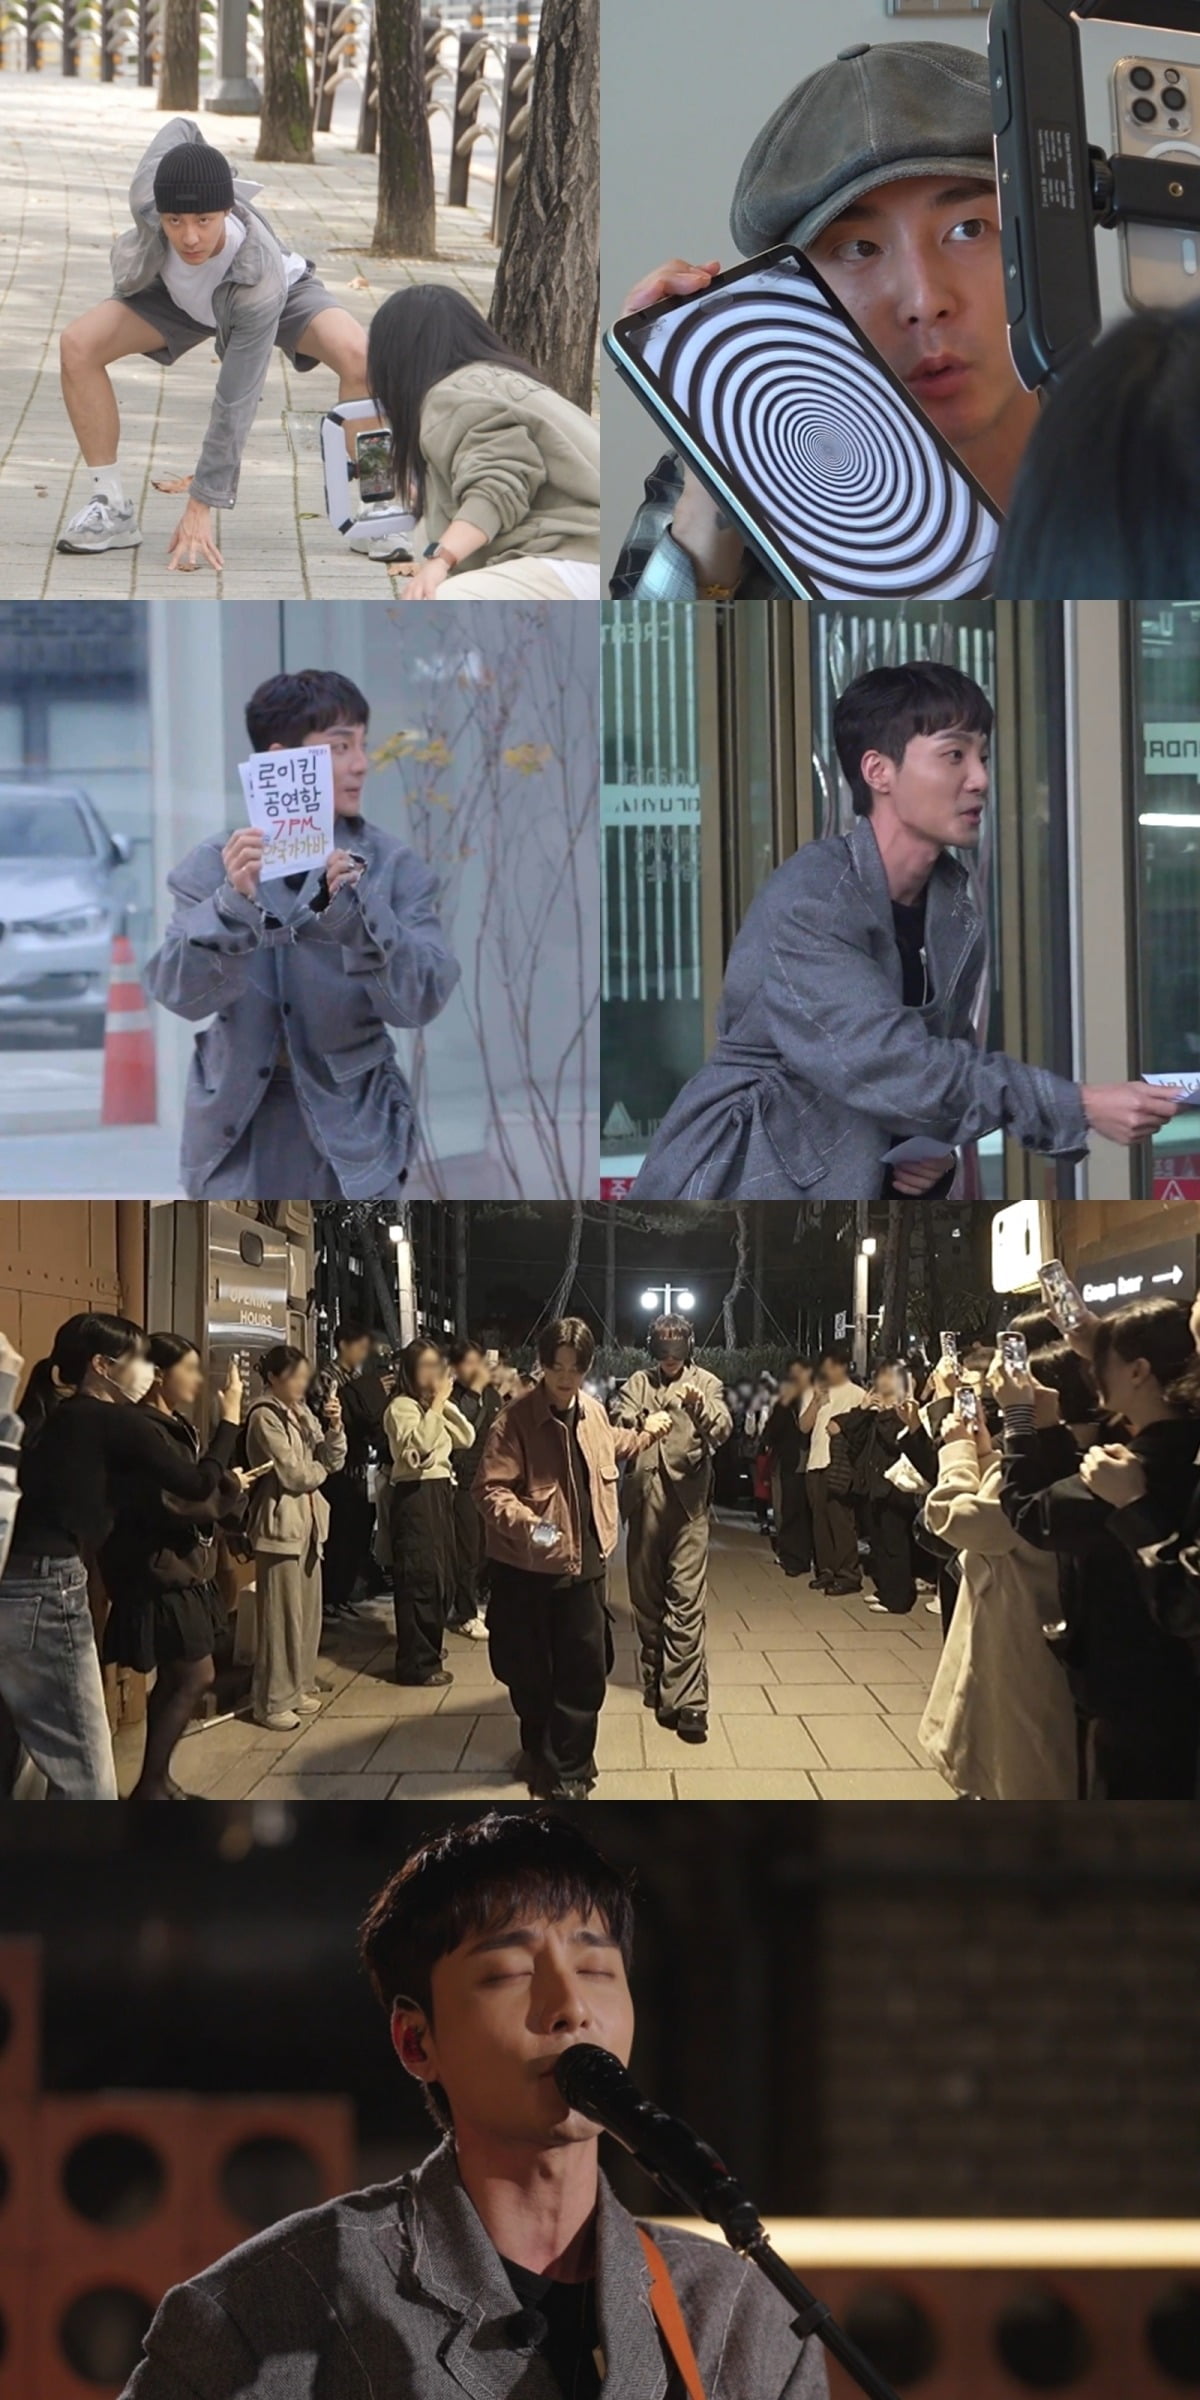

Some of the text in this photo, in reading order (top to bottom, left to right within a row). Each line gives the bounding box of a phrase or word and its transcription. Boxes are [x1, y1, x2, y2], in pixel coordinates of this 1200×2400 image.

[258, 755, 316, 789] 로이킴
[264, 785, 322, 817] 공연함
[262, 833, 328, 864] 안국가가바
[230, 1289, 272, 1310] OPENING
[240, 1310, 272, 1326] HOURS
